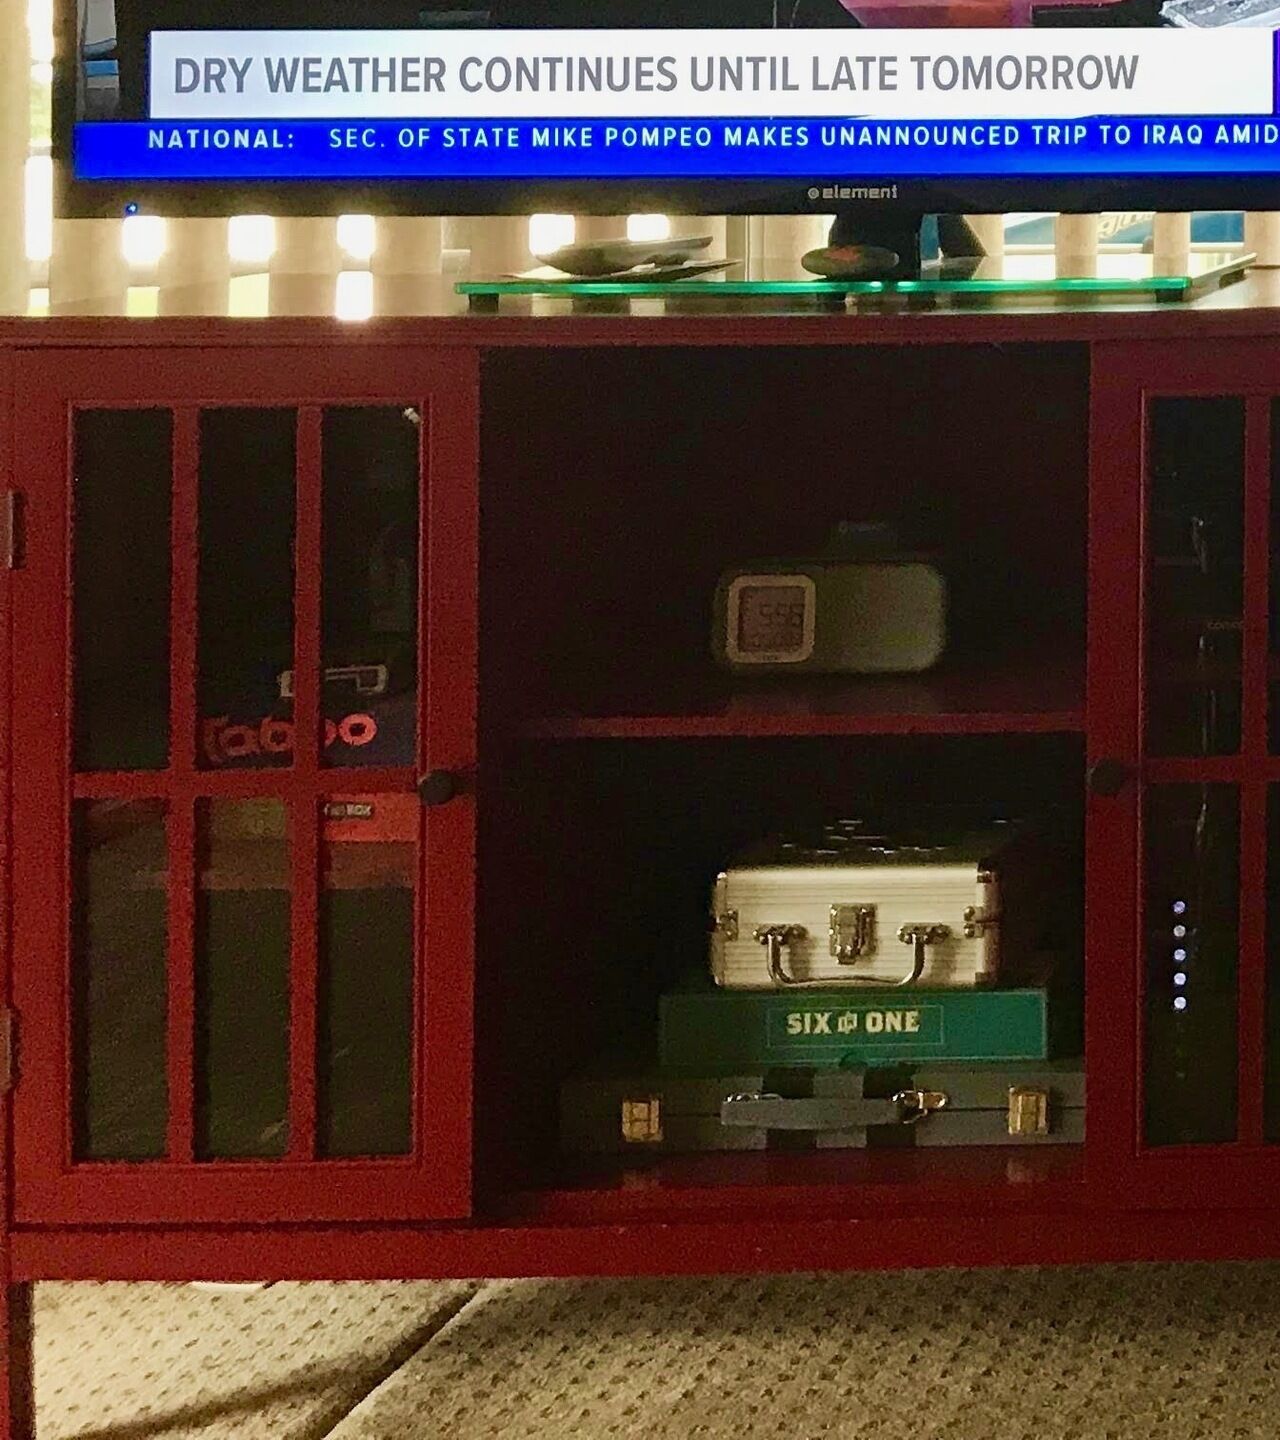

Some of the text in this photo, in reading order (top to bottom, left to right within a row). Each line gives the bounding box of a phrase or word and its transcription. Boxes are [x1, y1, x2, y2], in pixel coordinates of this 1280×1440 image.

[174, 55, 1139, 93] DRY WEATHER CONTINUES UNTIL LATE TOMORROW
[148, 128, 294, 149] NATIONAL:
[329, 128, 385, 148] SEC.
[398, 128, 431, 148] OF
[442, 127, 520, 148] STATE
[532, 127, 593, 147] MIKE
[605, 127, 712, 147] POMPEO
[724, 126, 809, 147] MAKES
[821, 125, 1020, 147] UNANNOUNCED
[1031, 125, 1088, 145] TRIP
[1099, 124, 1131, 145] TO
[1143, 124, 1203, 144] IRAQ
[1214, 124, 1279, 144] AMID
[822, 184, 899, 200] element
[786, 1011, 833, 1035] SIX
[865, 1009, 921, 1033] ONE
